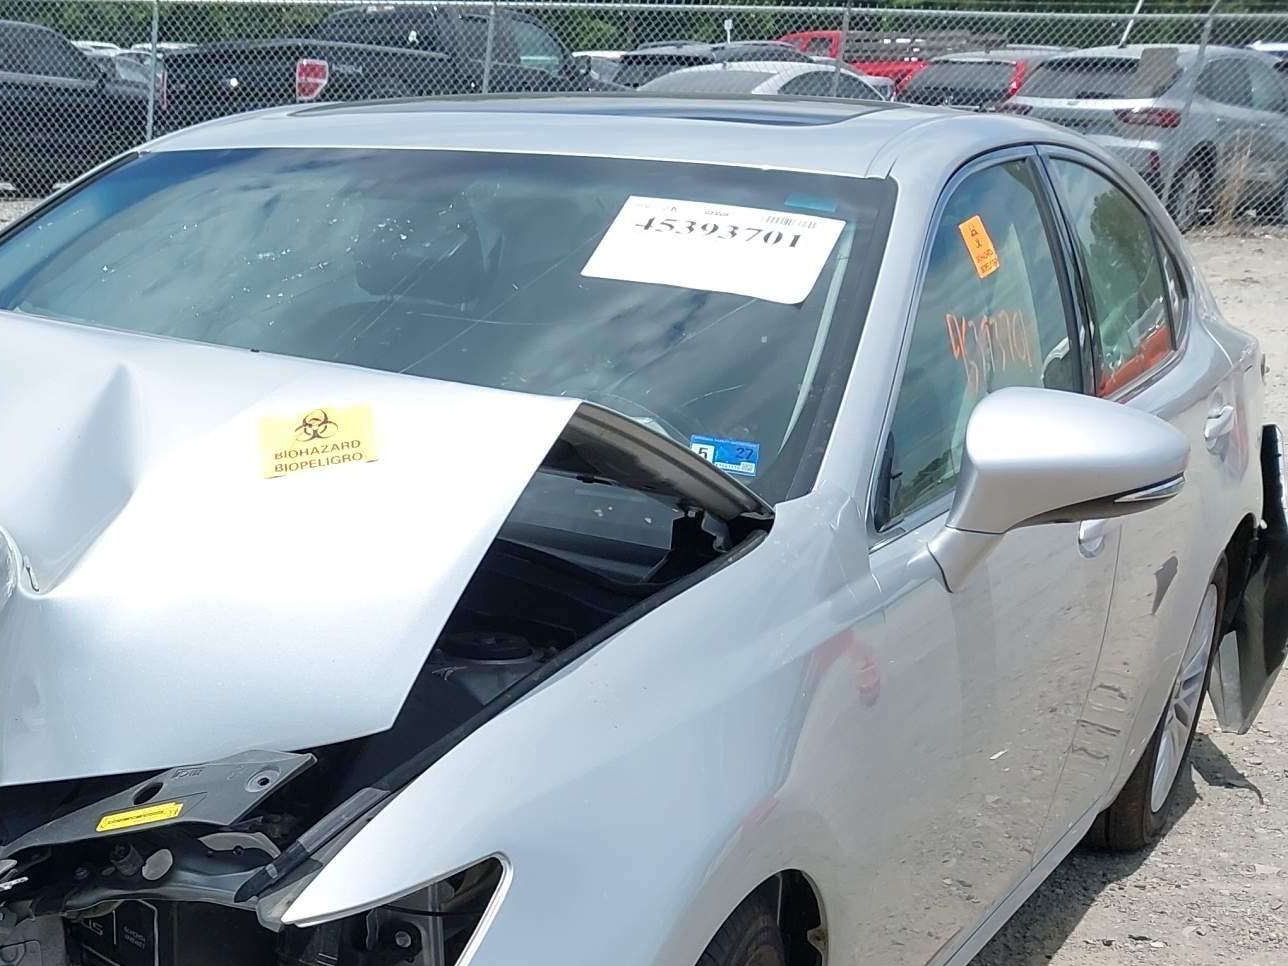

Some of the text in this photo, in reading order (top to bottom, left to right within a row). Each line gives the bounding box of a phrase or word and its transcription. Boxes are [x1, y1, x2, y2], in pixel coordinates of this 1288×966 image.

[634, 215, 802, 248] 45393701
[274, 439, 361, 460] BIOHAZARD
[698, 447, 754, 460] 5 27
[274, 452, 363, 473] BIOPELIGRO
